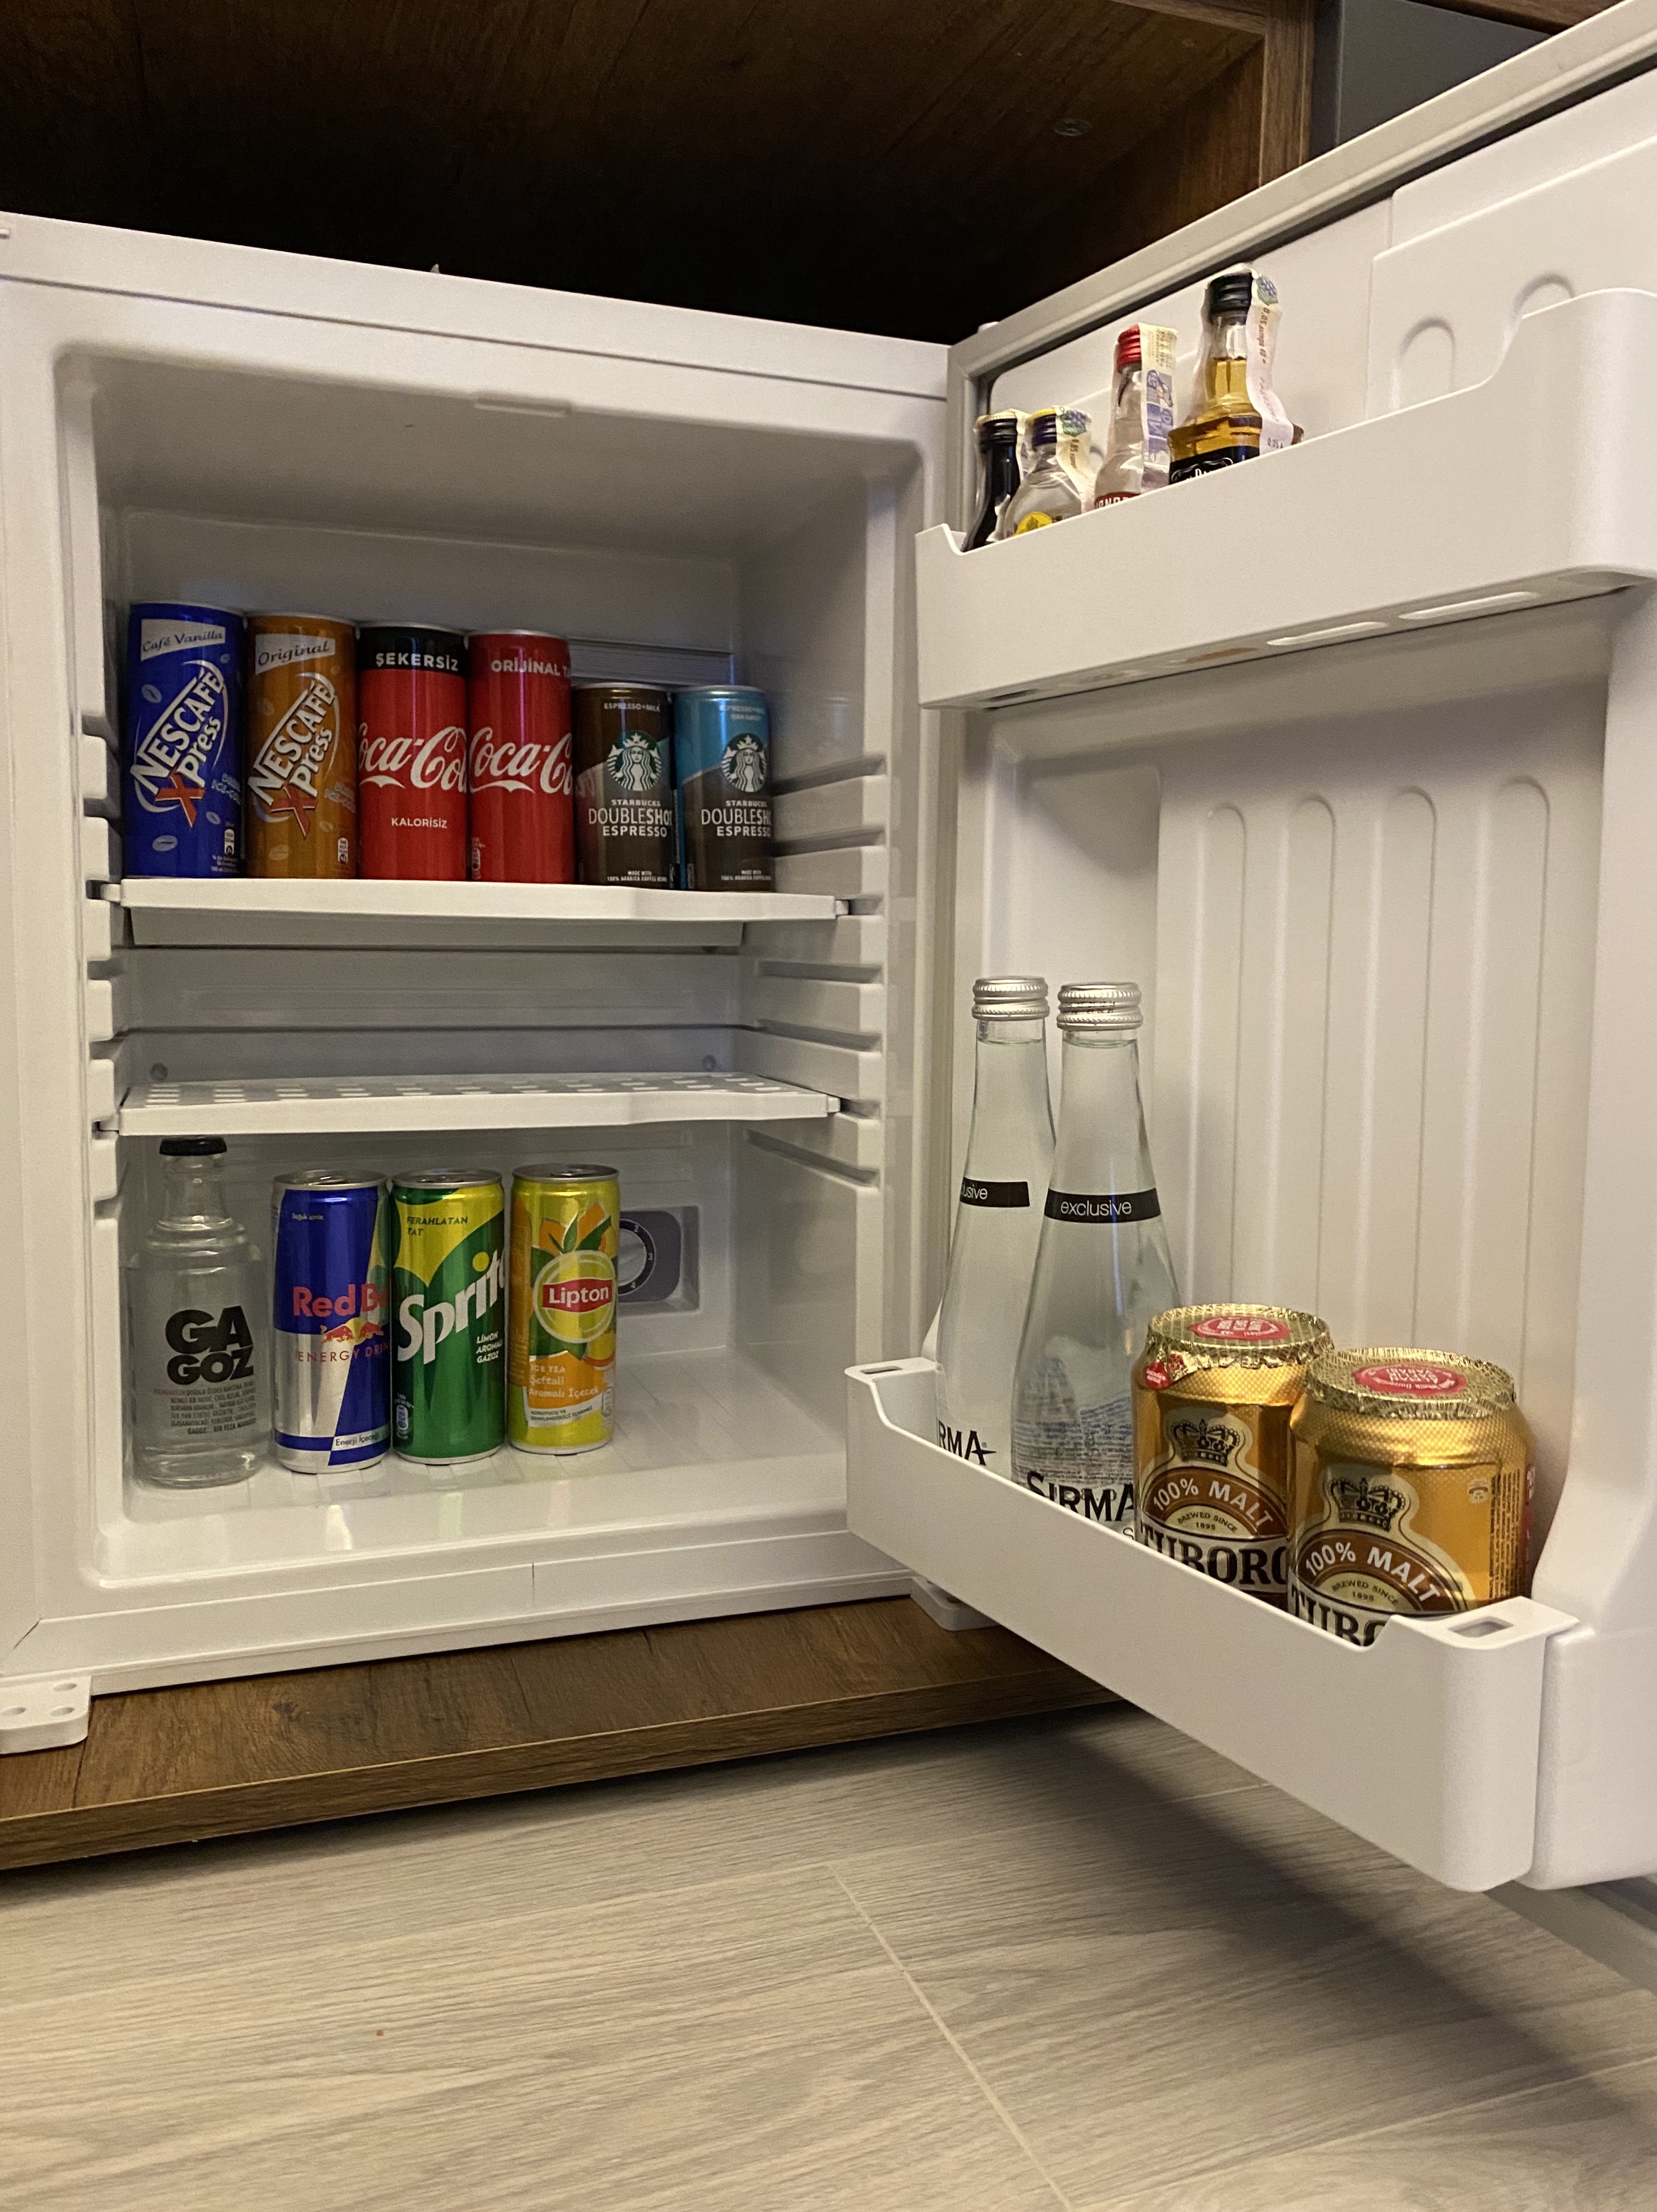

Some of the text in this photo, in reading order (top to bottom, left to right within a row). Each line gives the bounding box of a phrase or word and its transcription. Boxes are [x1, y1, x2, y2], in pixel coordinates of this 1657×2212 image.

[142, 629, 224, 653] Café Vanilla
[258, 640, 330, 666] Original
[376, 652, 458, 672] ŞEKERSİZ
[491, 657, 561, 676] ORİJİNAL
[392, 817, 448, 829] KALORİSİZ
[602, 825, 667, 838] ESPRESSO
[1060, 1200, 1132, 1217] exclusive
[407, 1215, 468, 1225] FERAHLATAN
[293, 1284, 356, 1317] Red
[548, 1285, 610, 1308] Lipton
[165, 1306, 253, 1355] GA
[166, 1345, 255, 1385] GOZ
[298, 1348, 360, 1363] ENERGY
[530, 1364, 566, 1373] ICE TEA
[1153, 1477, 1273, 1529] 100% MALT
[1177, 1511, 1238, 1532] BREWED SINCE
[1305, 1542, 1441, 1602] 100% MALT
[1332, 1580, 1400, 1605] BREWED SINCE
